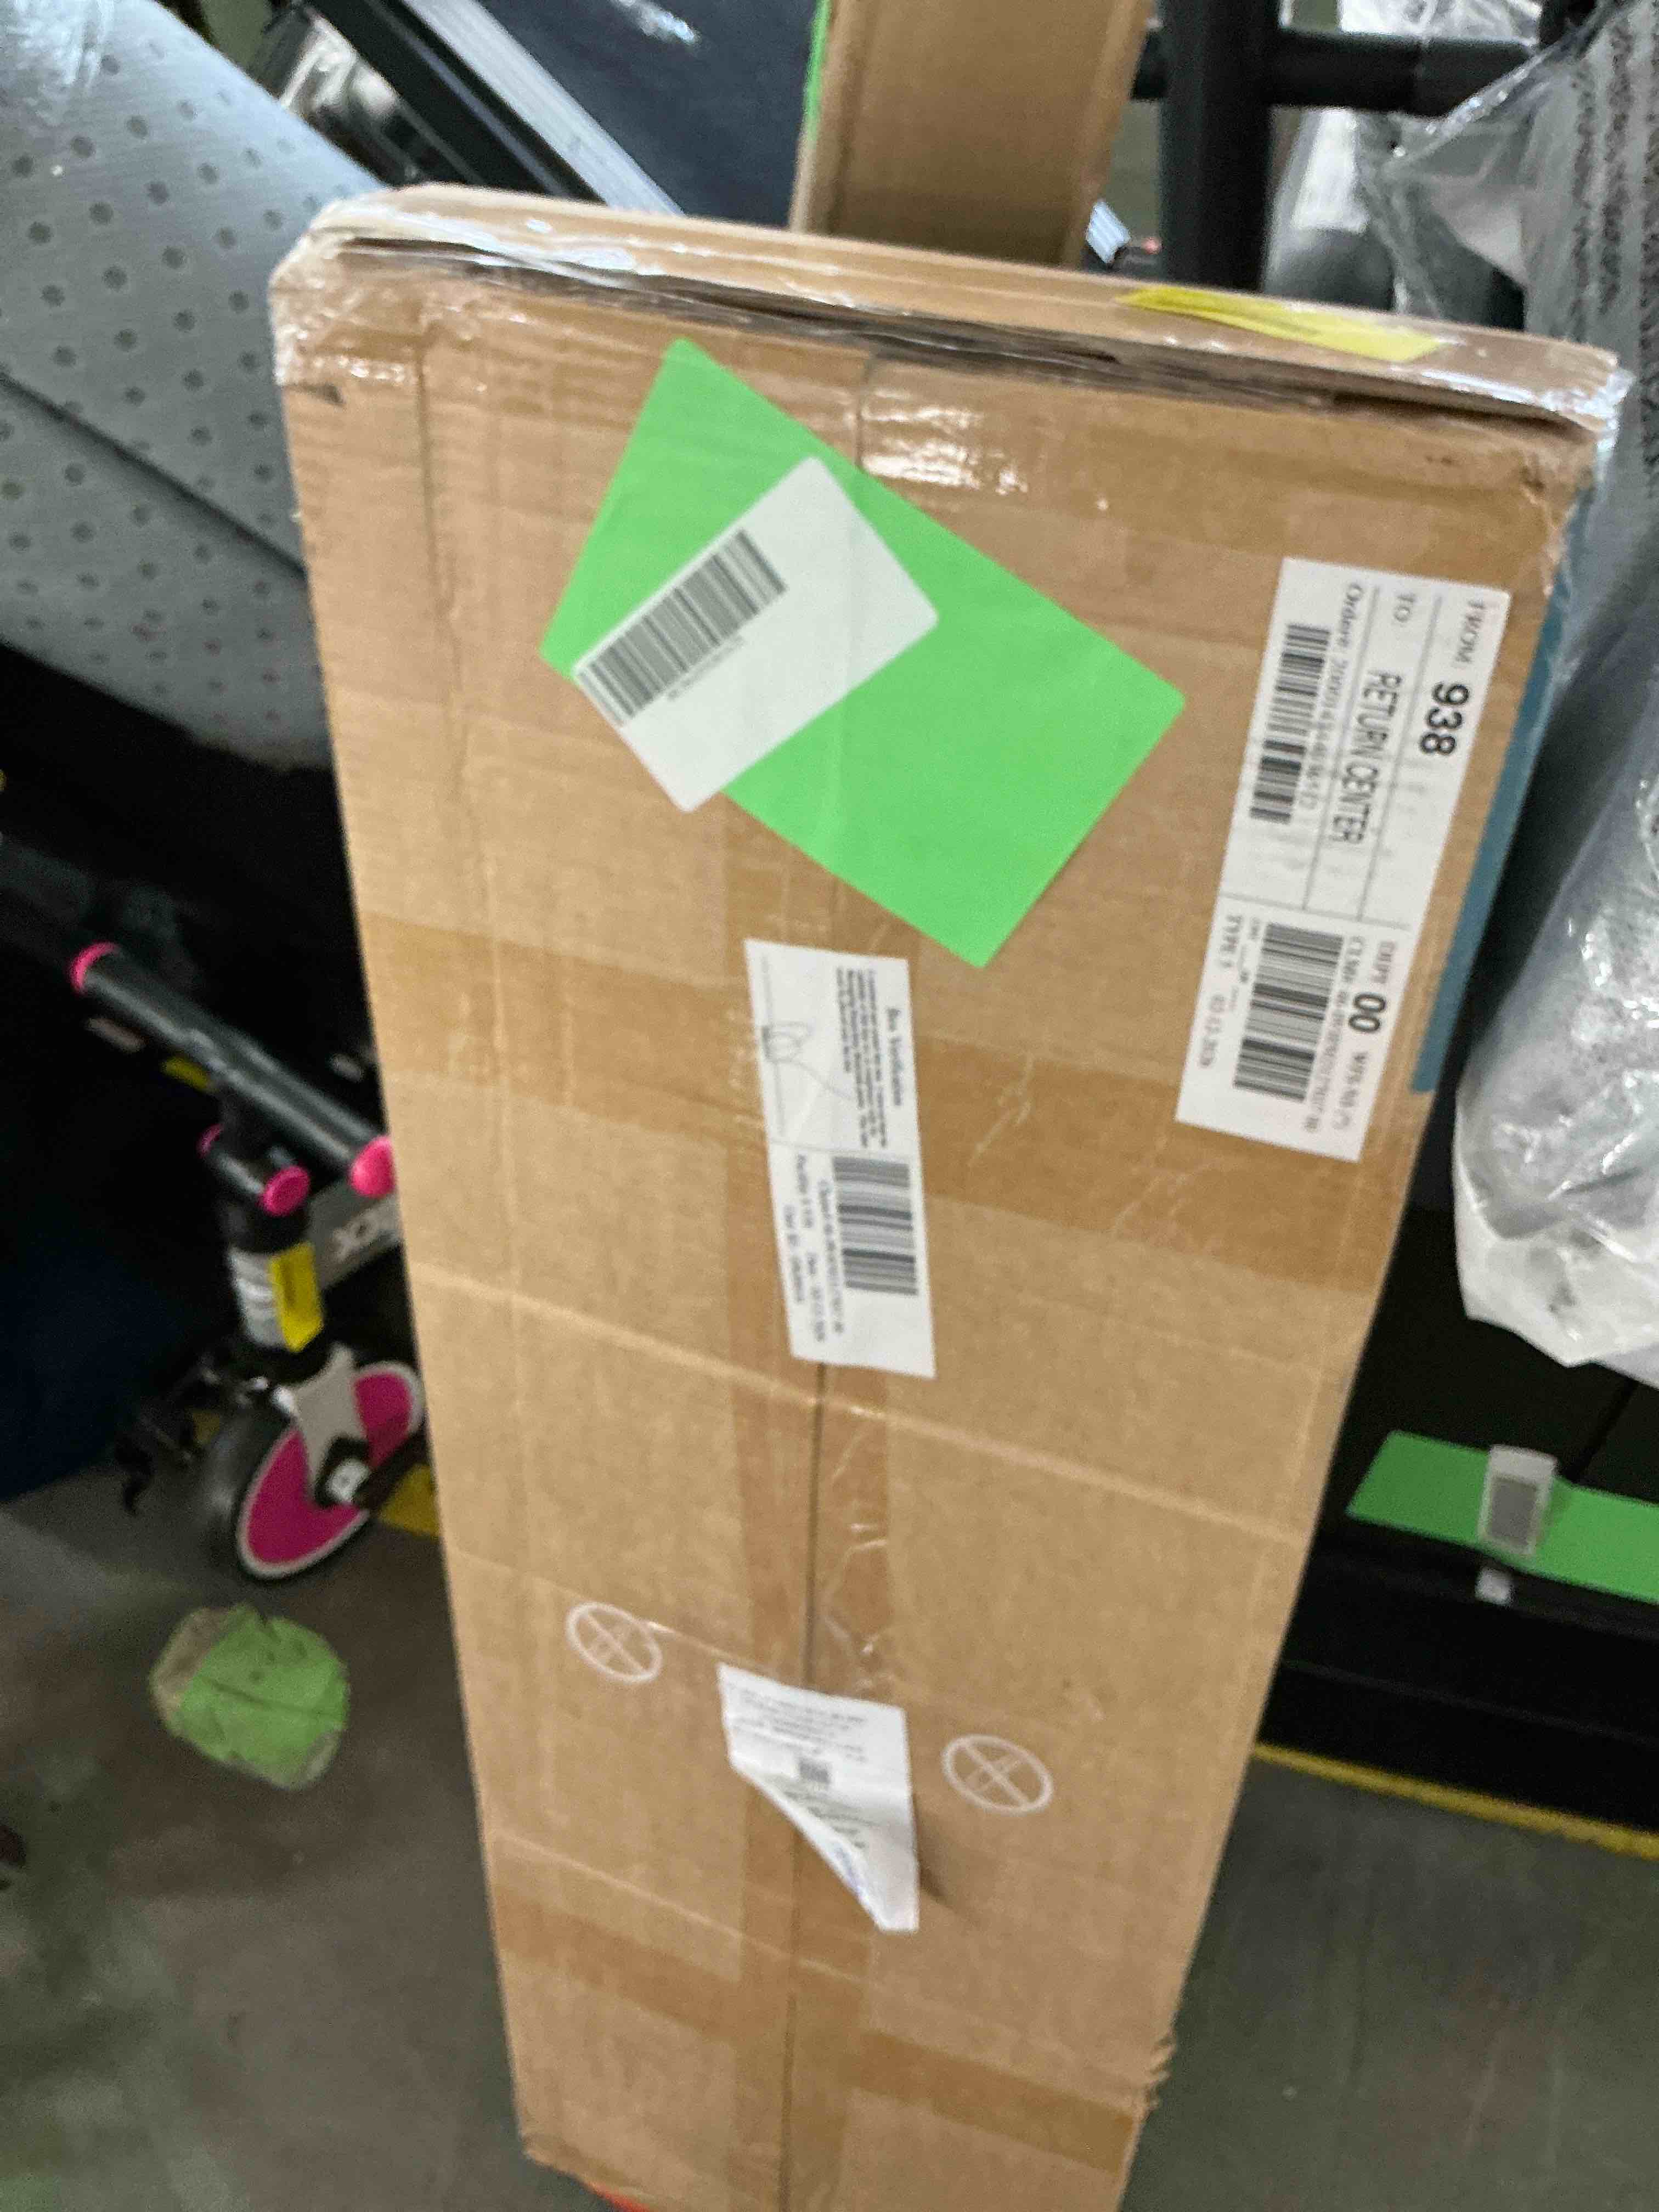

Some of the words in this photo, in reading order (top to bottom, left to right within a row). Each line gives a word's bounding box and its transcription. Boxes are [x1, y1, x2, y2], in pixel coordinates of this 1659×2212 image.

[1350, 670, 1403, 759] RETURN
[1420, 681, 1471, 756] 938
[1329, 763, 1379, 844] CENTER
[1347, 992, 1387, 1034] 00
